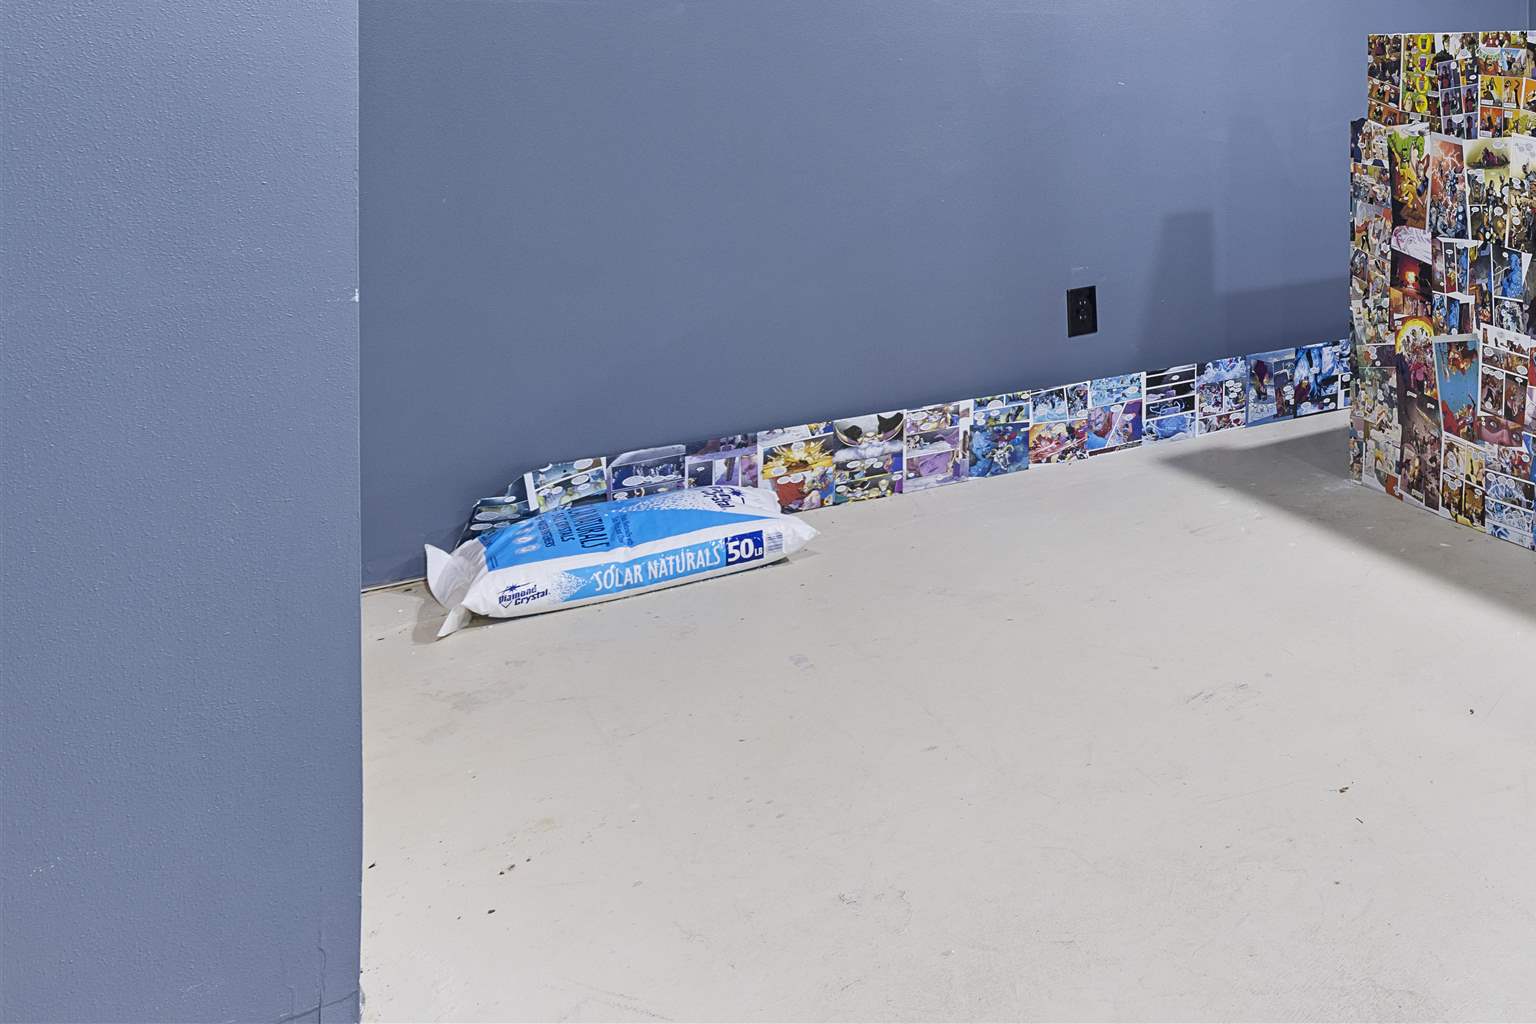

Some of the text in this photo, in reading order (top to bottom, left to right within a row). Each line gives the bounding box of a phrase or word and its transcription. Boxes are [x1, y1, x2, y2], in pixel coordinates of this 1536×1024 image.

[594, 564, 643, 591] SOLAR
[648, 546, 721, 579] NATURALS
[727, 538, 754, 562] 50
[498, 585, 537, 604] Diamond
[514, 588, 548, 606] Crystal
